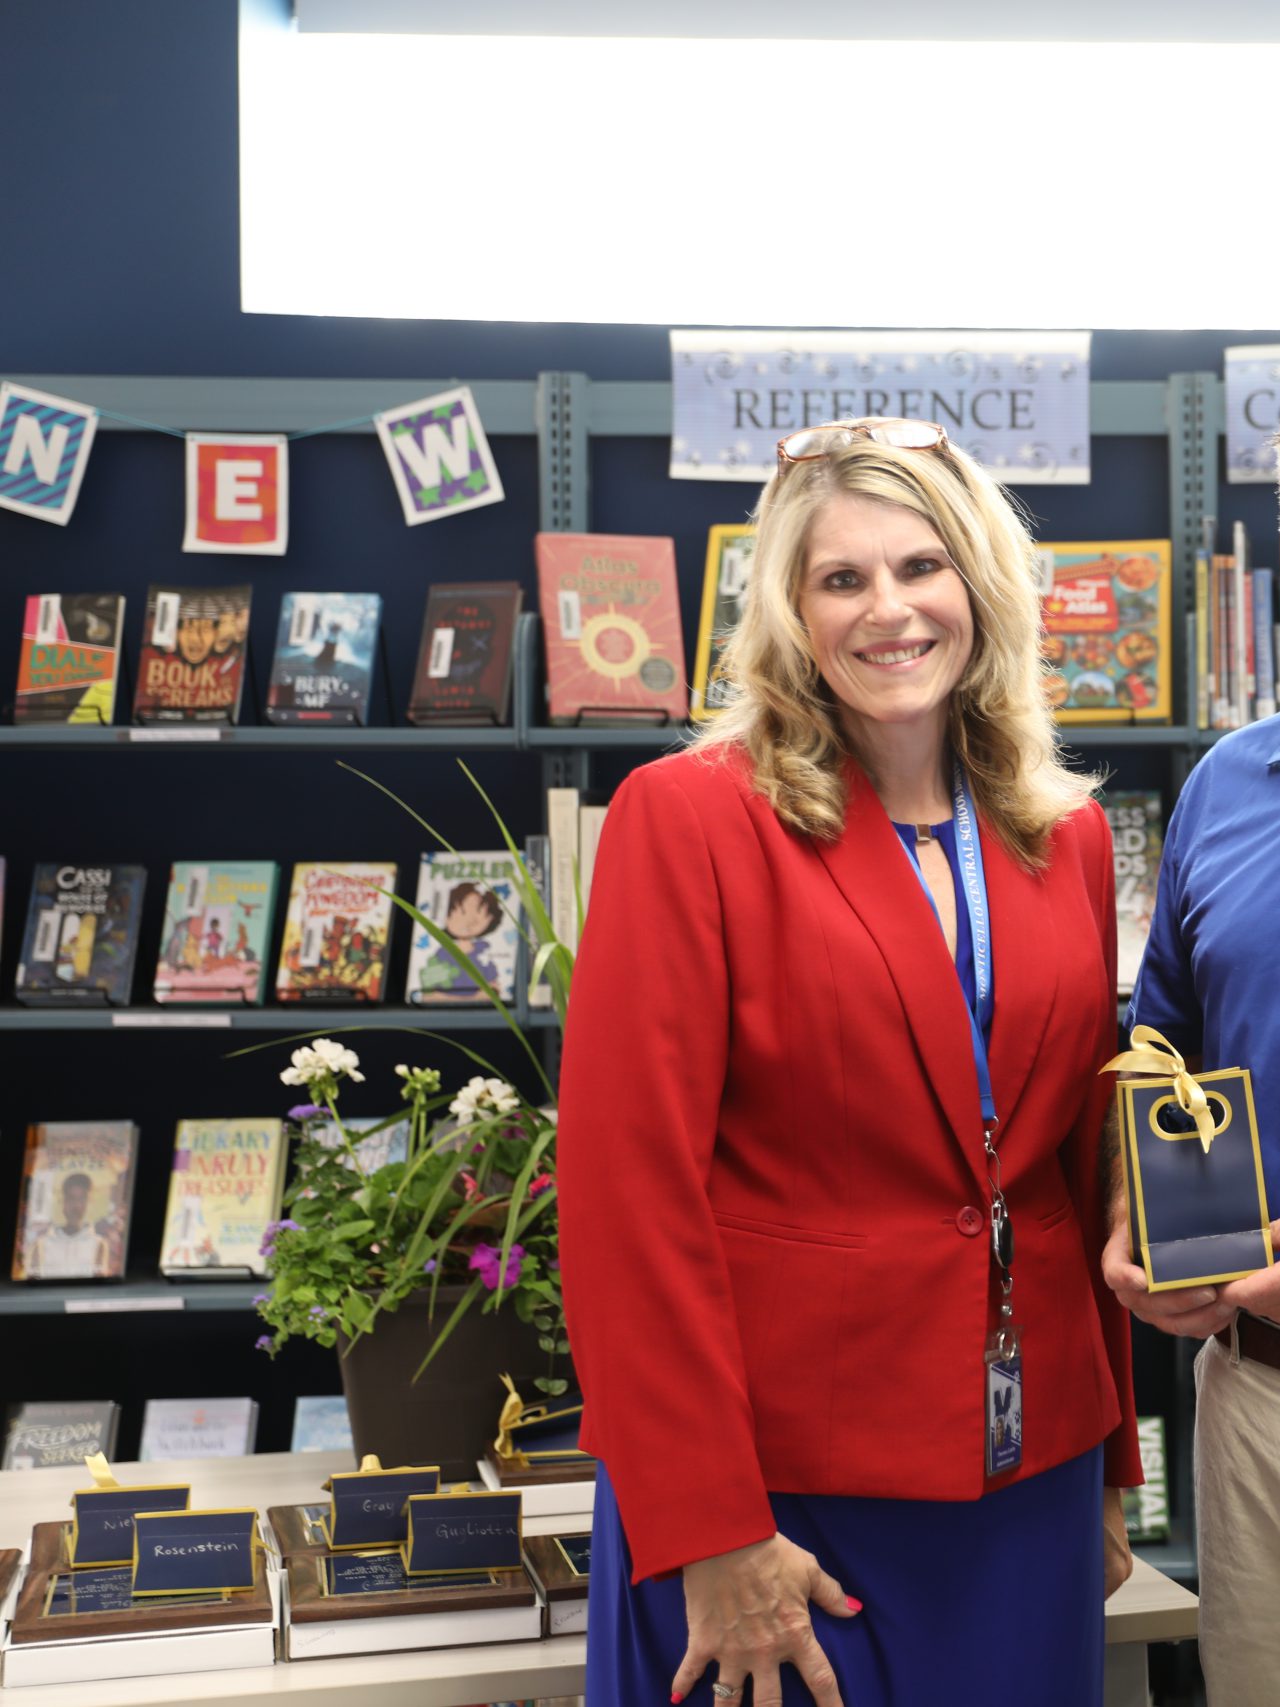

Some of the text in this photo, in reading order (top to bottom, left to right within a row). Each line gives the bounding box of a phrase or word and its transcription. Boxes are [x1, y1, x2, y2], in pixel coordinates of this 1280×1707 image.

[146, 659, 219, 689] BOOK
[57, 865, 112, 890] CASSI
[956, 793, 988, 1000] MONTICELLO CENTRAL SCHOOL
[193, 1151, 271, 1177] NRULY
[154, 1542, 240, 1557] Rosenstein
